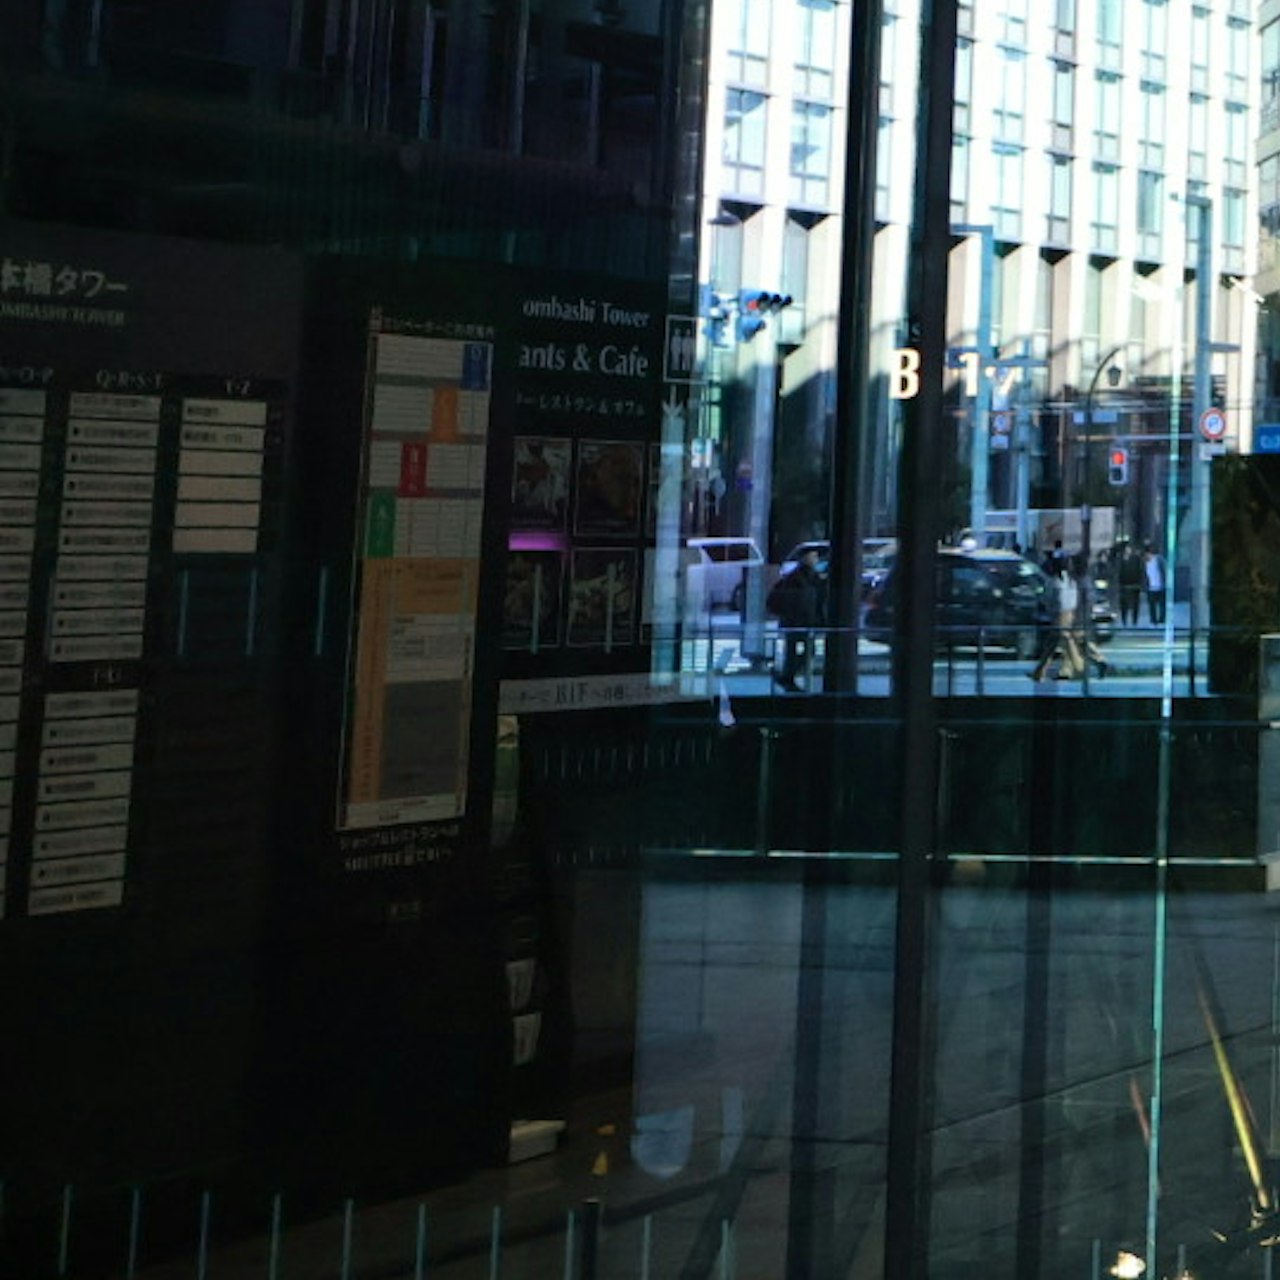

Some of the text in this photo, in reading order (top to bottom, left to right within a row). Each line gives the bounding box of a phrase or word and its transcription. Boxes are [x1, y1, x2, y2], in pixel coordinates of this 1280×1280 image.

[522, 295, 650, 328] ombashi Tower
[518, 342, 649, 378] ants & Cafe
[889, 347, 920, 399] B
